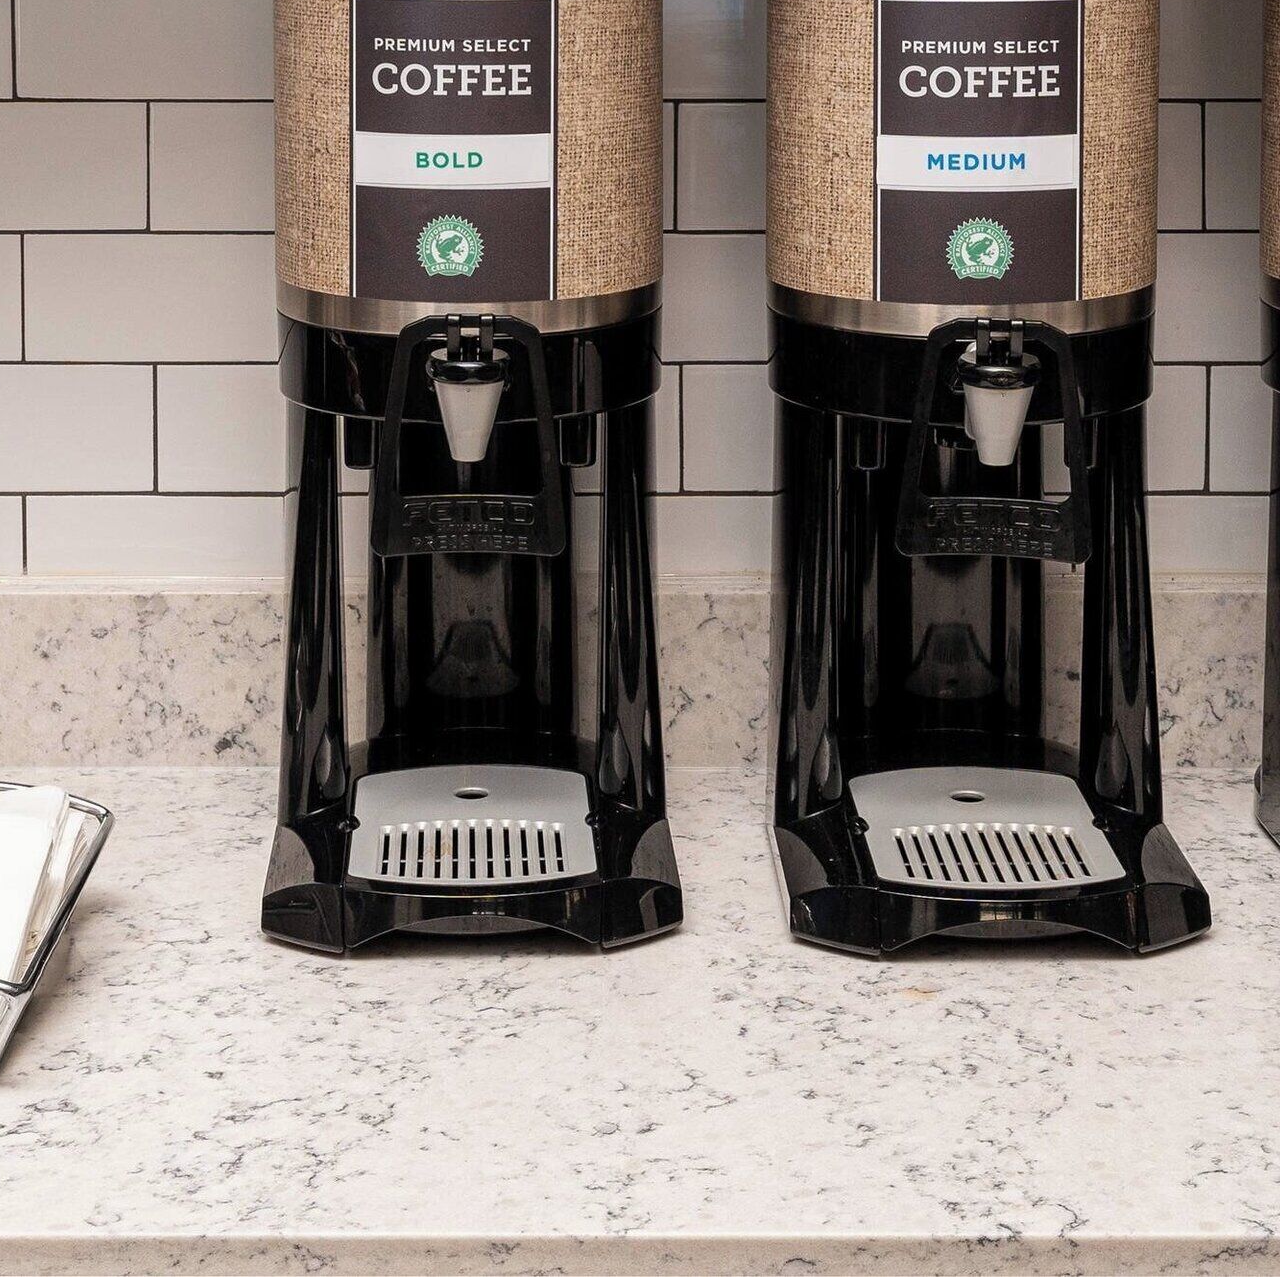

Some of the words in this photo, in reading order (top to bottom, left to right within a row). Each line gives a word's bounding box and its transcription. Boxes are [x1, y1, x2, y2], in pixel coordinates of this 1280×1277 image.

[374, 38, 455, 53] PREMIUM
[462, 38, 531, 53] SELECT
[901, 40, 986, 54] PREMIUM
[993, 40, 1060, 54] SELECT
[371, 63, 532, 96] COFFEE
[899, 65, 1060, 98] COFFEE
[415, 151, 483, 169] BOLD
[927, 152, 1026, 171] MEDIUM
[425, 224, 454, 254] RAINFOREST
[456, 226, 475, 254] ALLIANCE
[955, 227, 985, 257] RAINFOREST
[986, 228, 1005, 257] ALLIANCE
[431, 262, 469, 272] CERTIFIED
[961, 265, 999, 275] CERTIFIED
[403, 499, 536, 526] FETCO
[928, 502, 1061, 532] FETCO
